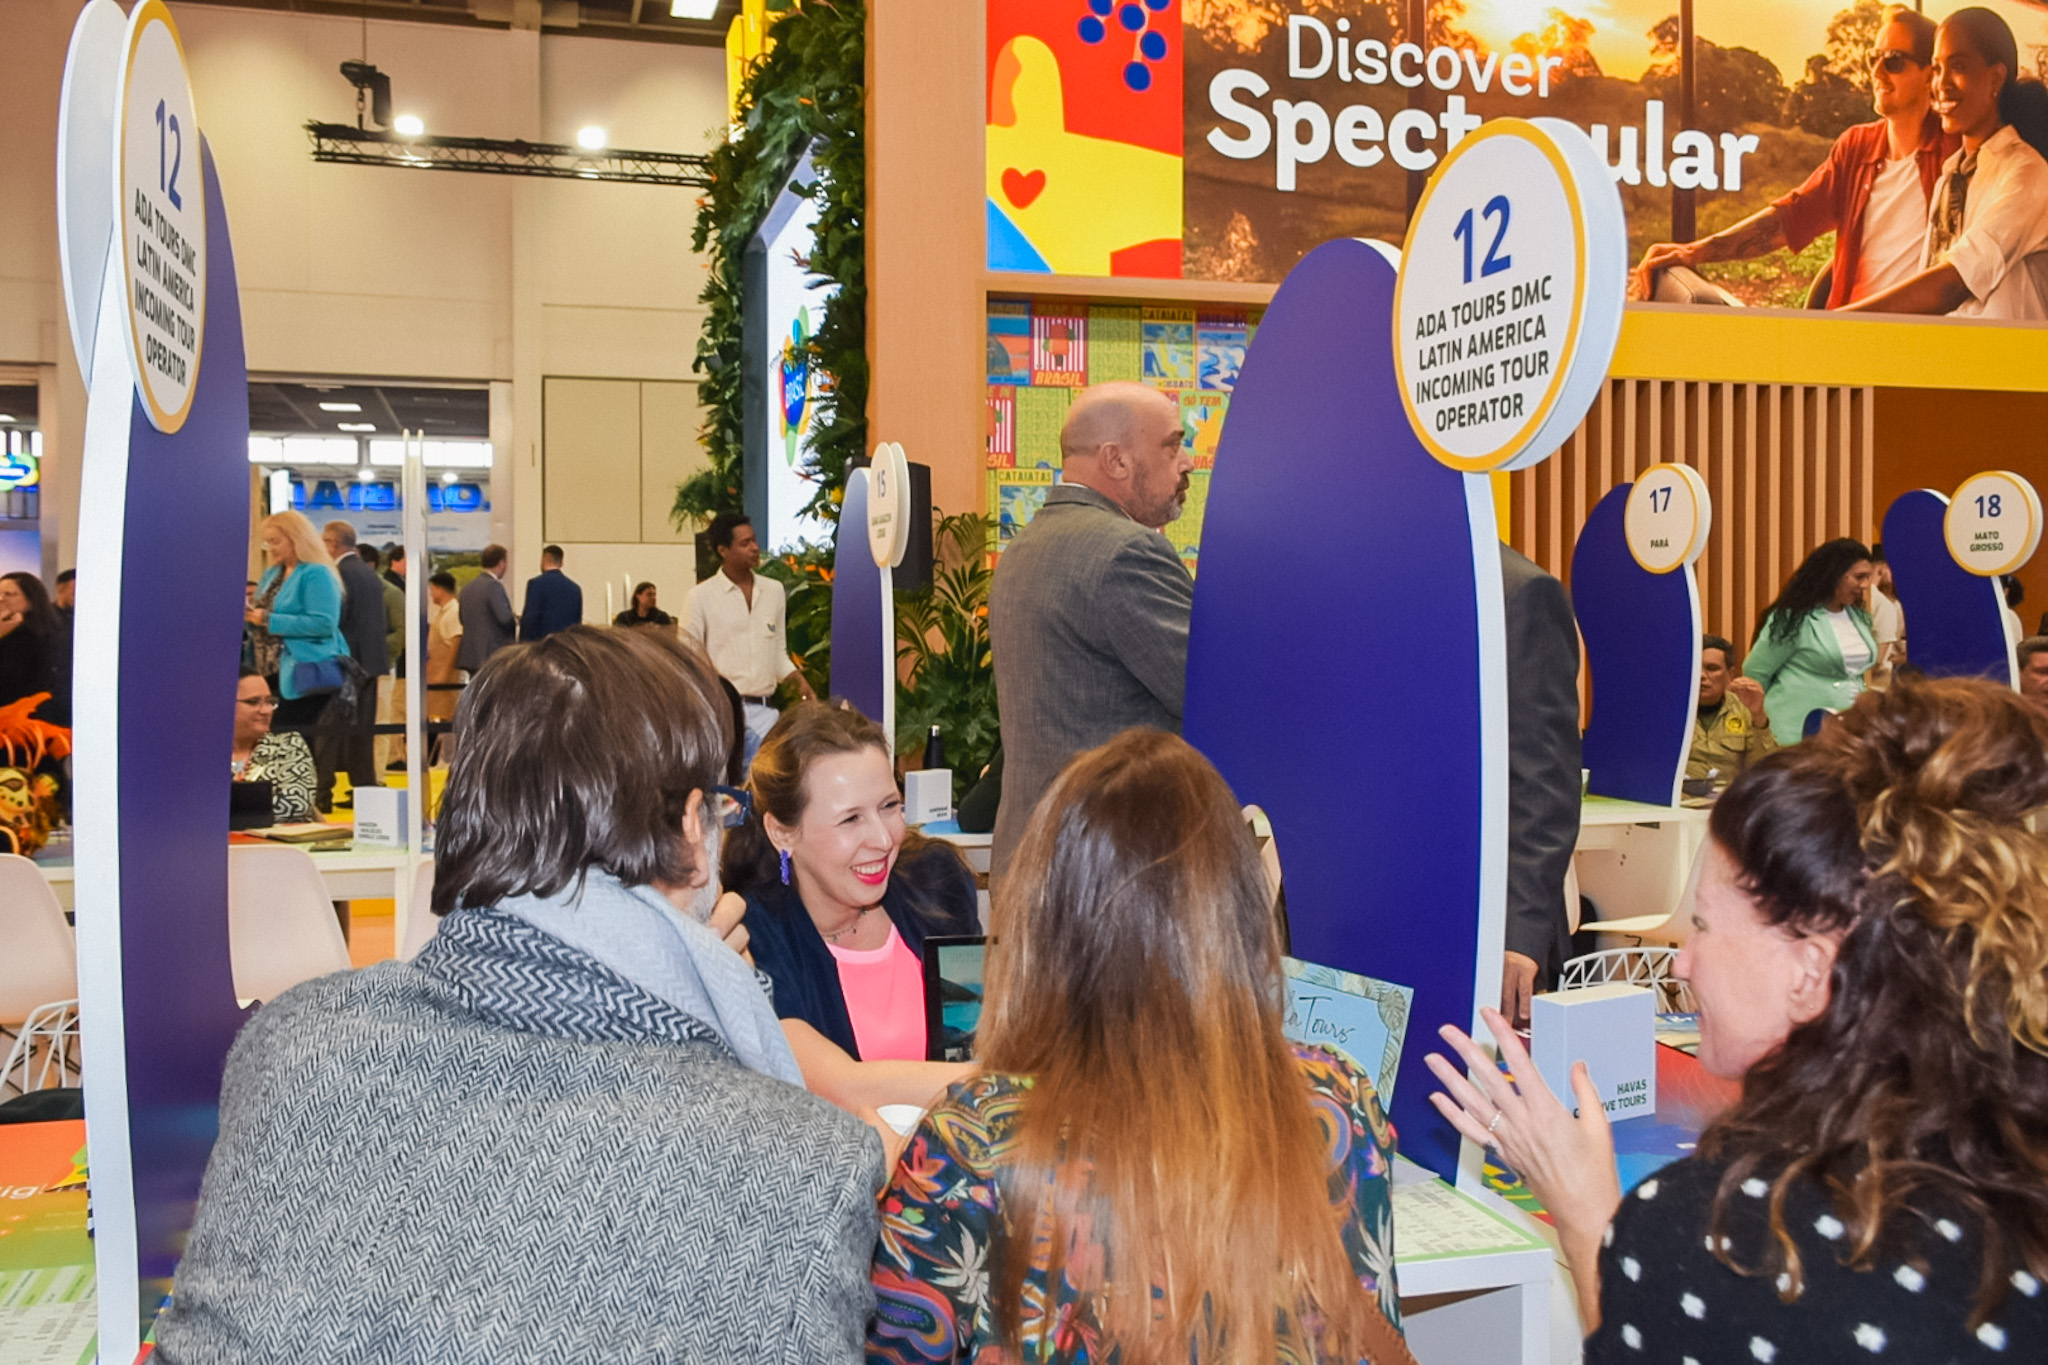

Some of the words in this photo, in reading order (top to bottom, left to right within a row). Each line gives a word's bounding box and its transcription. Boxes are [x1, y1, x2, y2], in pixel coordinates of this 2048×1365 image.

[1288, 13, 1562, 98] Discover
[1206, 68, 1760, 192] Spectular
[155, 98, 183, 213] 12
[135, 187, 153, 234] ADA
[155, 207, 180, 260] TOURS
[181, 236, 197, 278] DMC
[1453, 194, 1511, 285] 12
[137, 233, 161, 285] LATIN
[162, 260, 196, 316] AMERICA
[135, 277, 175, 339] INCOMING
[176, 314, 197, 356] TOUR
[1415, 309, 1447, 341] ADA
[1451, 290, 1506, 329] TOURS
[1511, 275, 1552, 312] DMC
[146, 332, 187, 388] OPERATOR
[1418, 337, 1463, 372] LATIN
[1467, 314, 1547, 359] AMERICA
[1034, 371, 1083, 387] BRASIL
[1200, 395, 1221, 407] TEM
[1416, 363, 1496, 405] INCOMING
[1500, 349, 1550, 385] TOUR
[1435, 392, 1524, 433] OPERATOR
[877, 469, 887, 498] 15
[986, 453, 1011, 468] SIL
[1649, 486, 1672, 513] 17
[1974, 493, 2002, 519] 18
[1969, 542, 2004, 552] GROSSO
[1974, 531, 2000, 541] MATO
[1298, 995, 1357, 1044] Tours
[1616, 1079, 1647, 1096] HAVAS
[1618, 1093, 1647, 1110] TOURS
